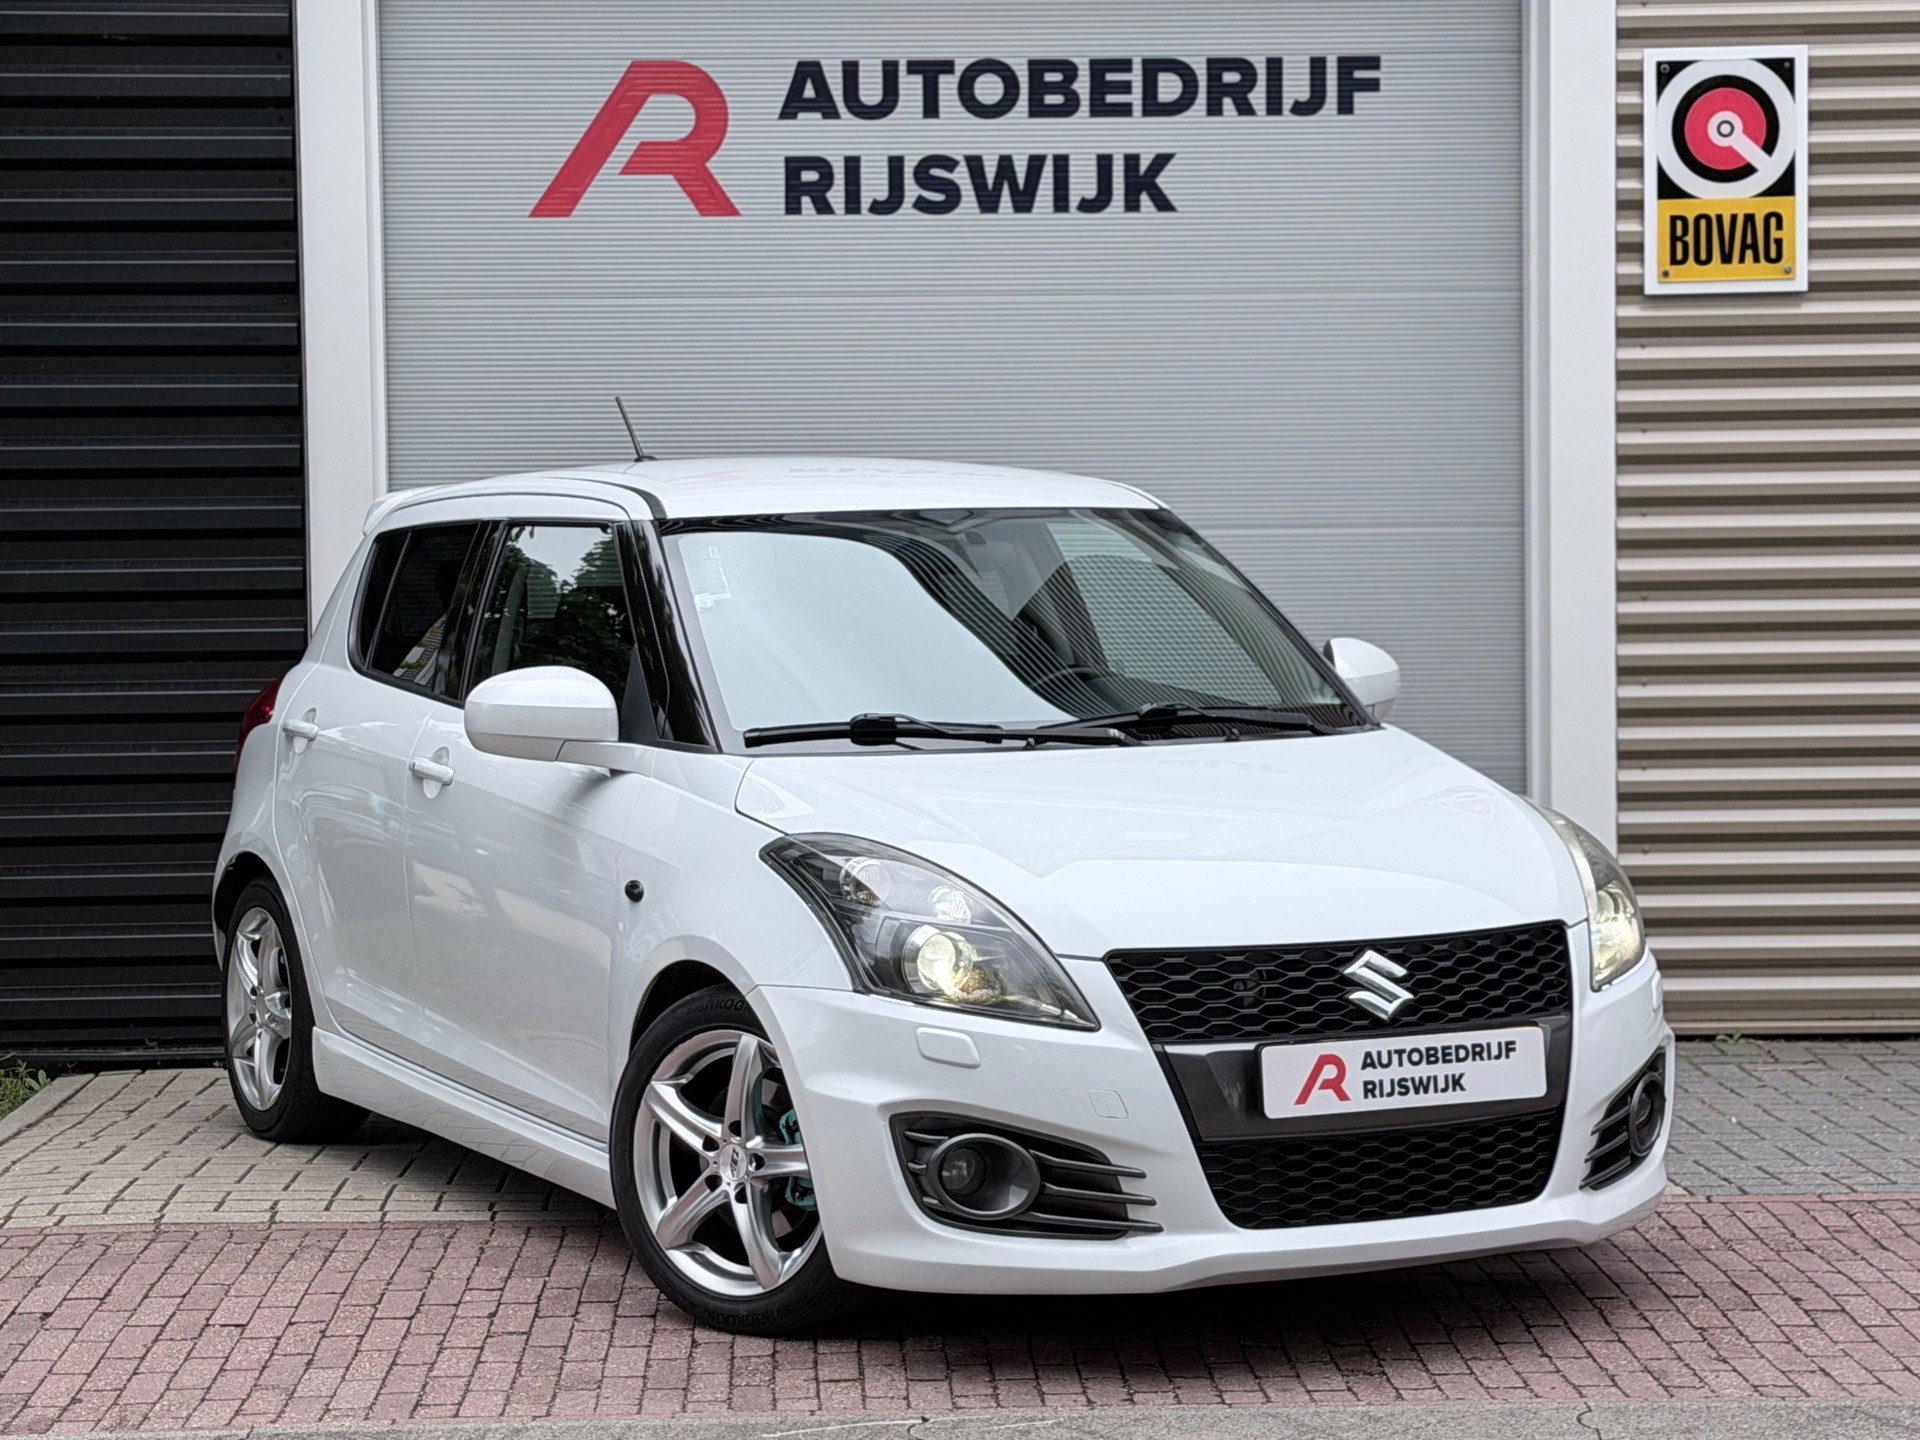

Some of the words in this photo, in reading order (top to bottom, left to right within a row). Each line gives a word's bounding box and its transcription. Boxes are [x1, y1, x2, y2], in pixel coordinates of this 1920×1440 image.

[778, 55, 1381, 120] AUTOBEDRIJF
[784, 152, 1178, 215] RIJSWIJK
[1669, 211, 1784, 266] BOVAG
[1361, 1040, 1517, 1071] AUTOBEDRIJF
[1363, 1072, 1467, 1100] RIJSWIJK
